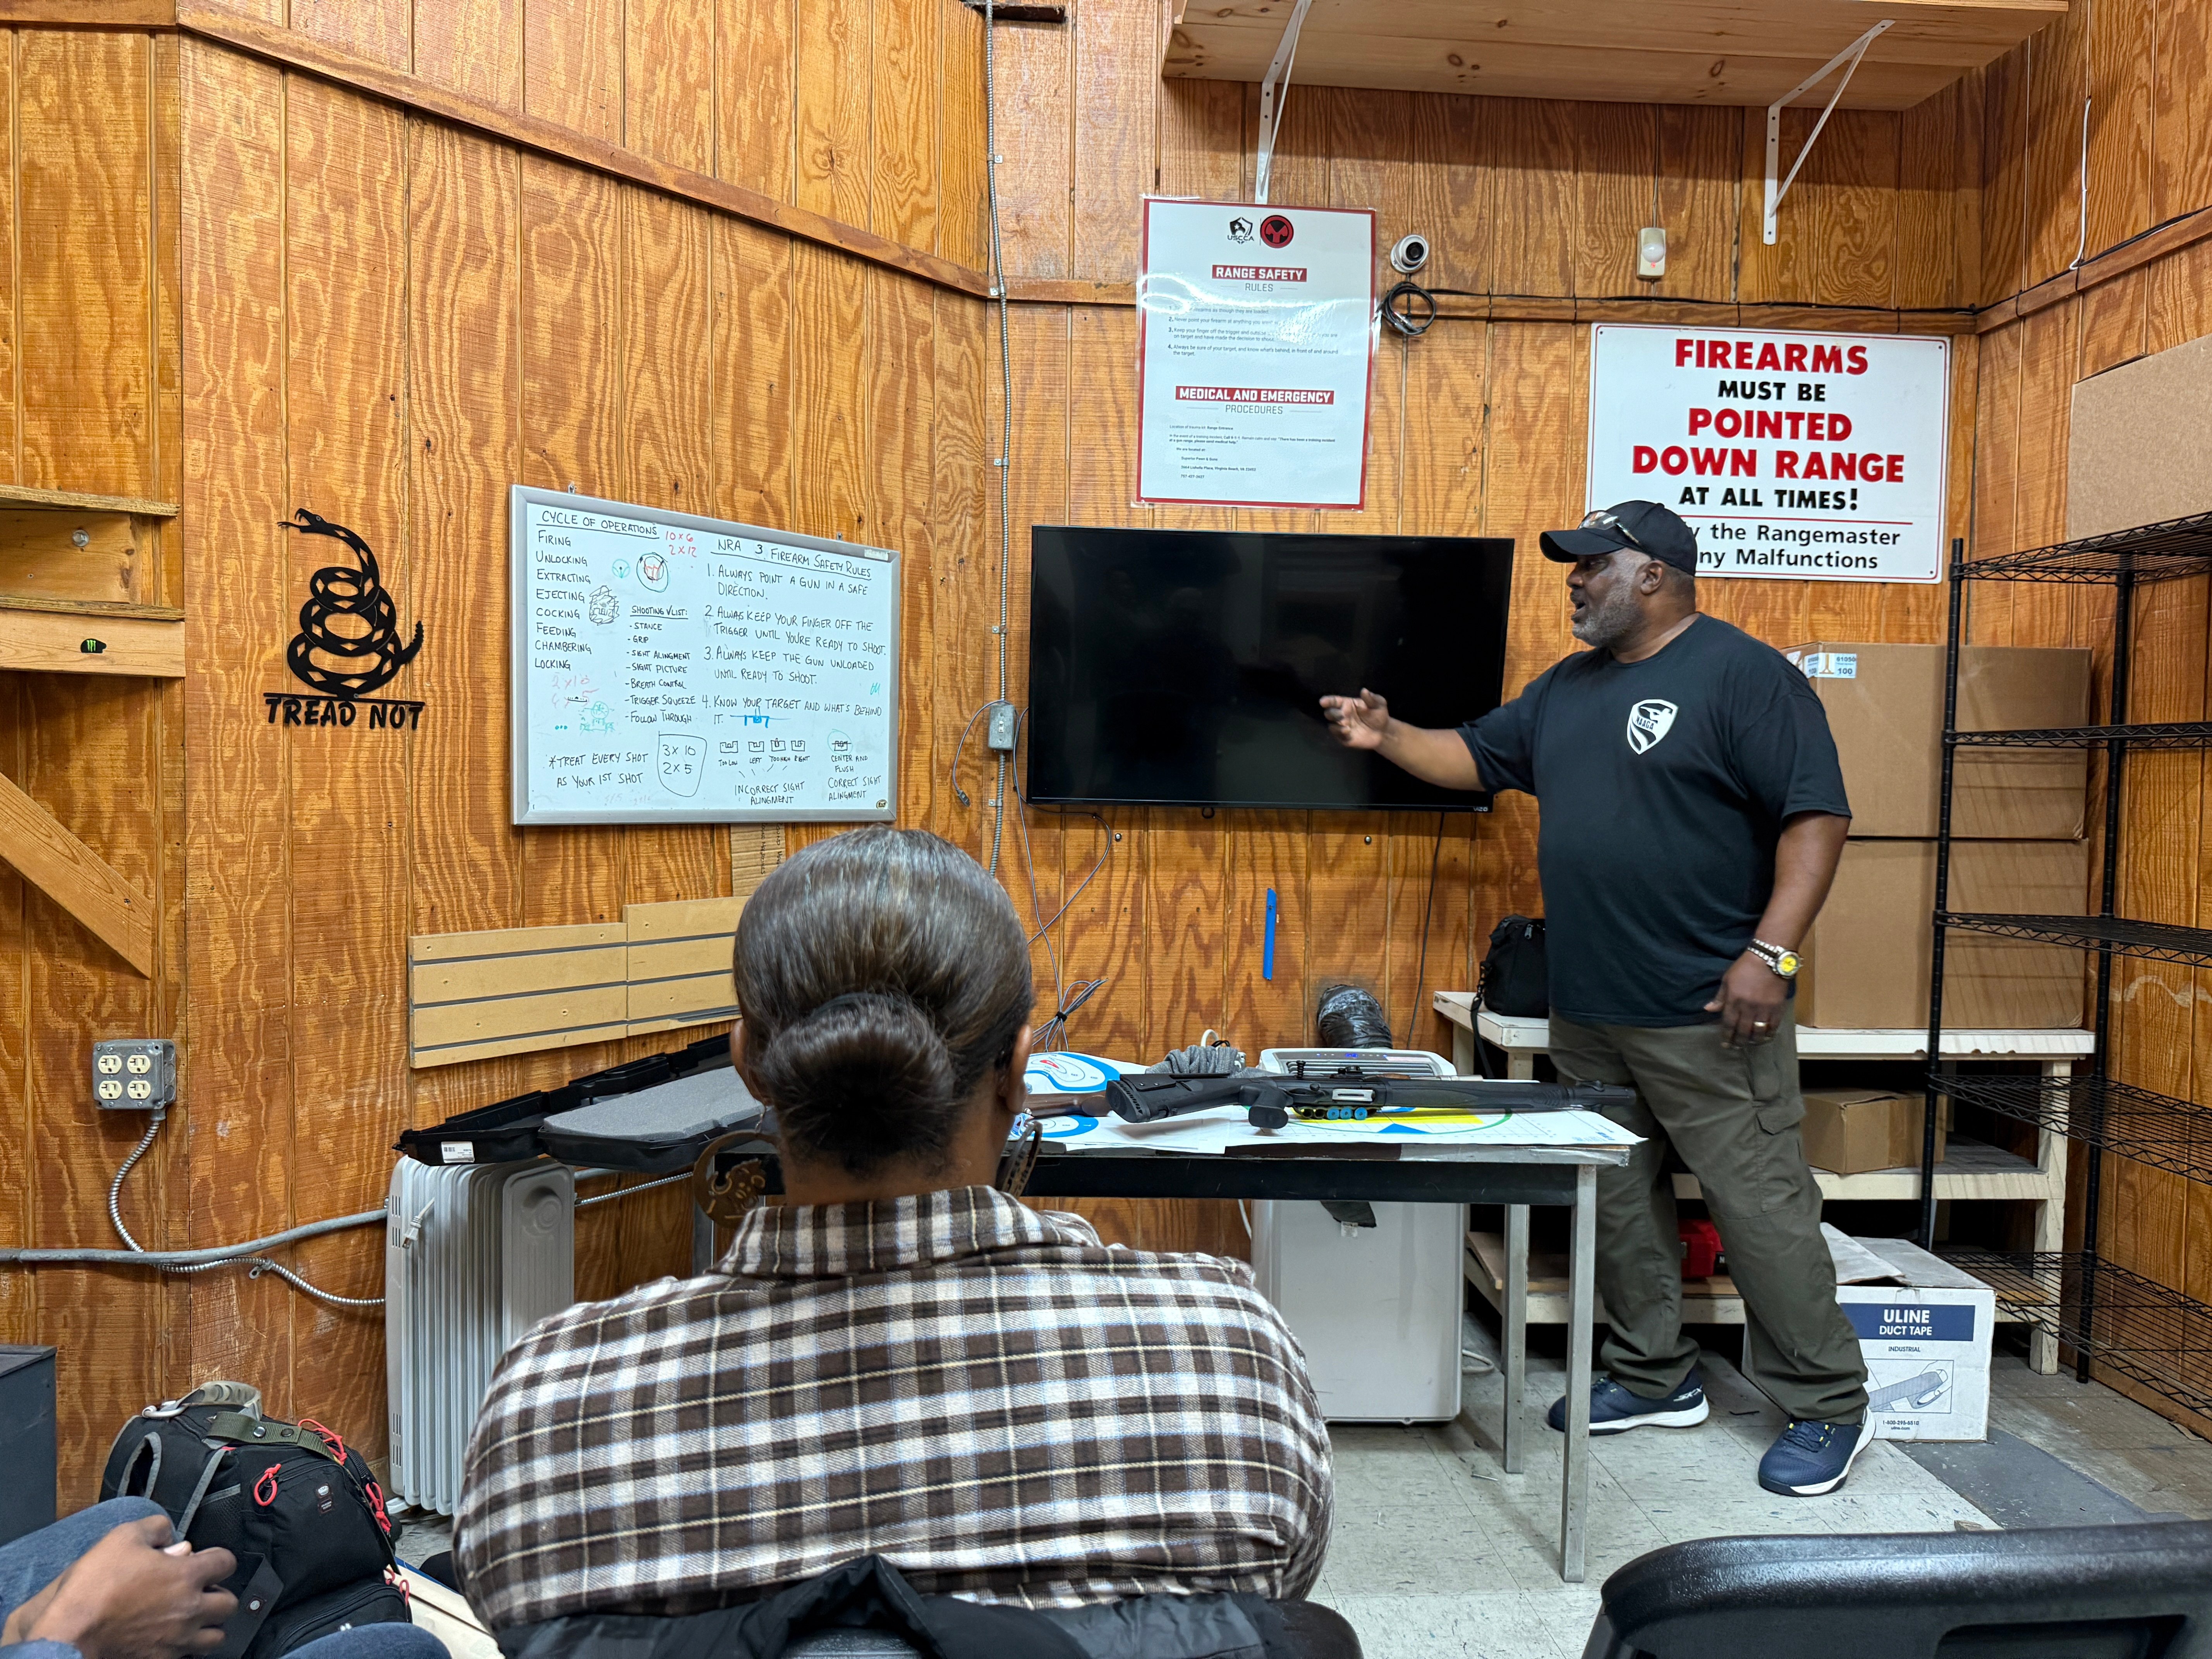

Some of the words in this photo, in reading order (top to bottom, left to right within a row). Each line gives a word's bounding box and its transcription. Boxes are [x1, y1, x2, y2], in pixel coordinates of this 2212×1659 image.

[1216, 267, 1255, 278] RANGE
[1259, 269, 1303, 280] SAFETY
[1245, 283, 1273, 292] RULES
[1675, 338, 1868, 375] FIREARMS
[1180, 388, 1230, 400] MEDICAL
[1233, 390, 1258, 401] AND
[1261, 390, 1330, 402] EMERGENCY
[1718, 380, 1786, 400] MUST
[1798, 383, 1826, 402] BE
[1226, 405, 1283, 414] PROCEDURES
[1688, 408, 1852, 441] POINTED
[1633, 446, 1757, 477] DOWN
[1775, 450, 1904, 483] RANGE
[1679, 487, 1709, 505] AT
[1721, 488, 1763, 507] ALL
[1774, 489, 1858, 510] TIMES!
[542, 511, 577, 524] CYCLE
[583, 517, 595, 526] OF
[601, 520, 657, 535] OPERATIONS
[538, 530, 571, 546] FIRING
[1711, 523, 1746, 540] the
[1757, 524, 1900, 546] Rangemaster
[536, 551, 587, 566] UNLOCKING
[718, 539, 741, 551] NRA
[771, 548, 809, 565] FIREARM
[814, 555, 843, 571] SAFETY
[847, 562, 871, 577] RULES
[1699, 550, 1725, 568] ny
[1736, 549, 1877, 568] Malfunctions
[537, 569, 591, 584] EXTRACTING
[708, 563, 714, 577] 1.
[719, 565, 752, 581] ALWAYS
[759, 572, 783, 583] POINT
[790, 576, 795, 585] A
[800, 579, 820, 589] GUN
[839, 583, 844, 591] A
[848, 585, 868, 595] SAFE
[536, 589, 585, 603] EJECTING
[718, 582, 768, 599] DIRECTION.
[536, 608, 580, 619] COCKING
[632, 606, 664, 614] SHOOTING
[718, 606, 744, 621] ALWAYS
[747, 611, 771, 622] KEEP
[775, 613, 797, 626] YOUR
[802, 617, 831, 628] FINGER
[835, 619, 852, 630] OFF
[856, 621, 873, 631] THE
[537, 623, 576, 637] FEEDING
[714, 623, 747, 637] TRIGGER
[756, 629, 780, 640] UNTIL
[816, 637, 842, 652] READY
[848, 642, 857, 651] TO
[862, 642, 886, 655] SHOOT.
[535, 641, 591, 654] CHAMBERING
[654, 651, 690, 659] ALINGMENT
[535, 658, 570, 670] LOCKING
[704, 646, 714, 660] 3.
[716, 646, 746, 660] ALWAYS
[752, 650, 776, 661] KEEP
[783, 653, 800, 664] THE
[805, 656, 824, 666] GUN
[831, 660, 874, 670] UNLOADED
[632, 663, 652, 672] SIGHT
[656, 665, 687, 673] PICTURE
[631, 678, 655, 689] BREATH
[659, 679, 687, 689] CONTROL
[714, 669, 737, 679] UNTIL
[742, 670, 766, 683] READY
[772, 670, 783, 681] TO
[789, 672, 817, 684] SHOOT.
[630, 695, 659, 706] TRIGGER
[662, 695, 696, 705] SQUEEZE
[702, 695, 711, 708] 4.
[714, 696, 737, 708] KNOW
[743, 698, 762, 708] YOUR
[765, 699, 801, 709] TARGET
[804, 702, 819, 711] AND
[824, 704, 850, 713] WHAT'S
[854, 705, 882, 716] BEHIND
[265, 698, 356, 726] TREAD
[369, 703, 424, 730] NOT
[631, 711, 657, 723] FOLLOW
[660, 709, 692, 724] THROUGH
[714, 714, 724, 725] IT.
[1635, 715, 1654, 730] NAAGA
[592, 753, 620, 764] EVERY
[626, 752, 648, 763] SHOT
[558, 777, 567, 787] AS
[572, 776, 594, 788] YOUR
[599, 773, 611, 784] 1ST
[619, 773, 643, 783] SHOT
[735, 784, 779, 795] INCORRECT
[783, 781, 805, 792] SIGHT
[828, 776, 858, 788] CORRECT
[863, 776, 881, 786] SIGHT
[751, 795, 794, 805] ALINGMENT
[829, 790, 867, 801] ALINGMENT
[1884, 1309, 1930, 1323] ULINE
[1880, 1326, 1908, 1335] DUCT
[1909, 1326, 1932, 1335] TAPE
